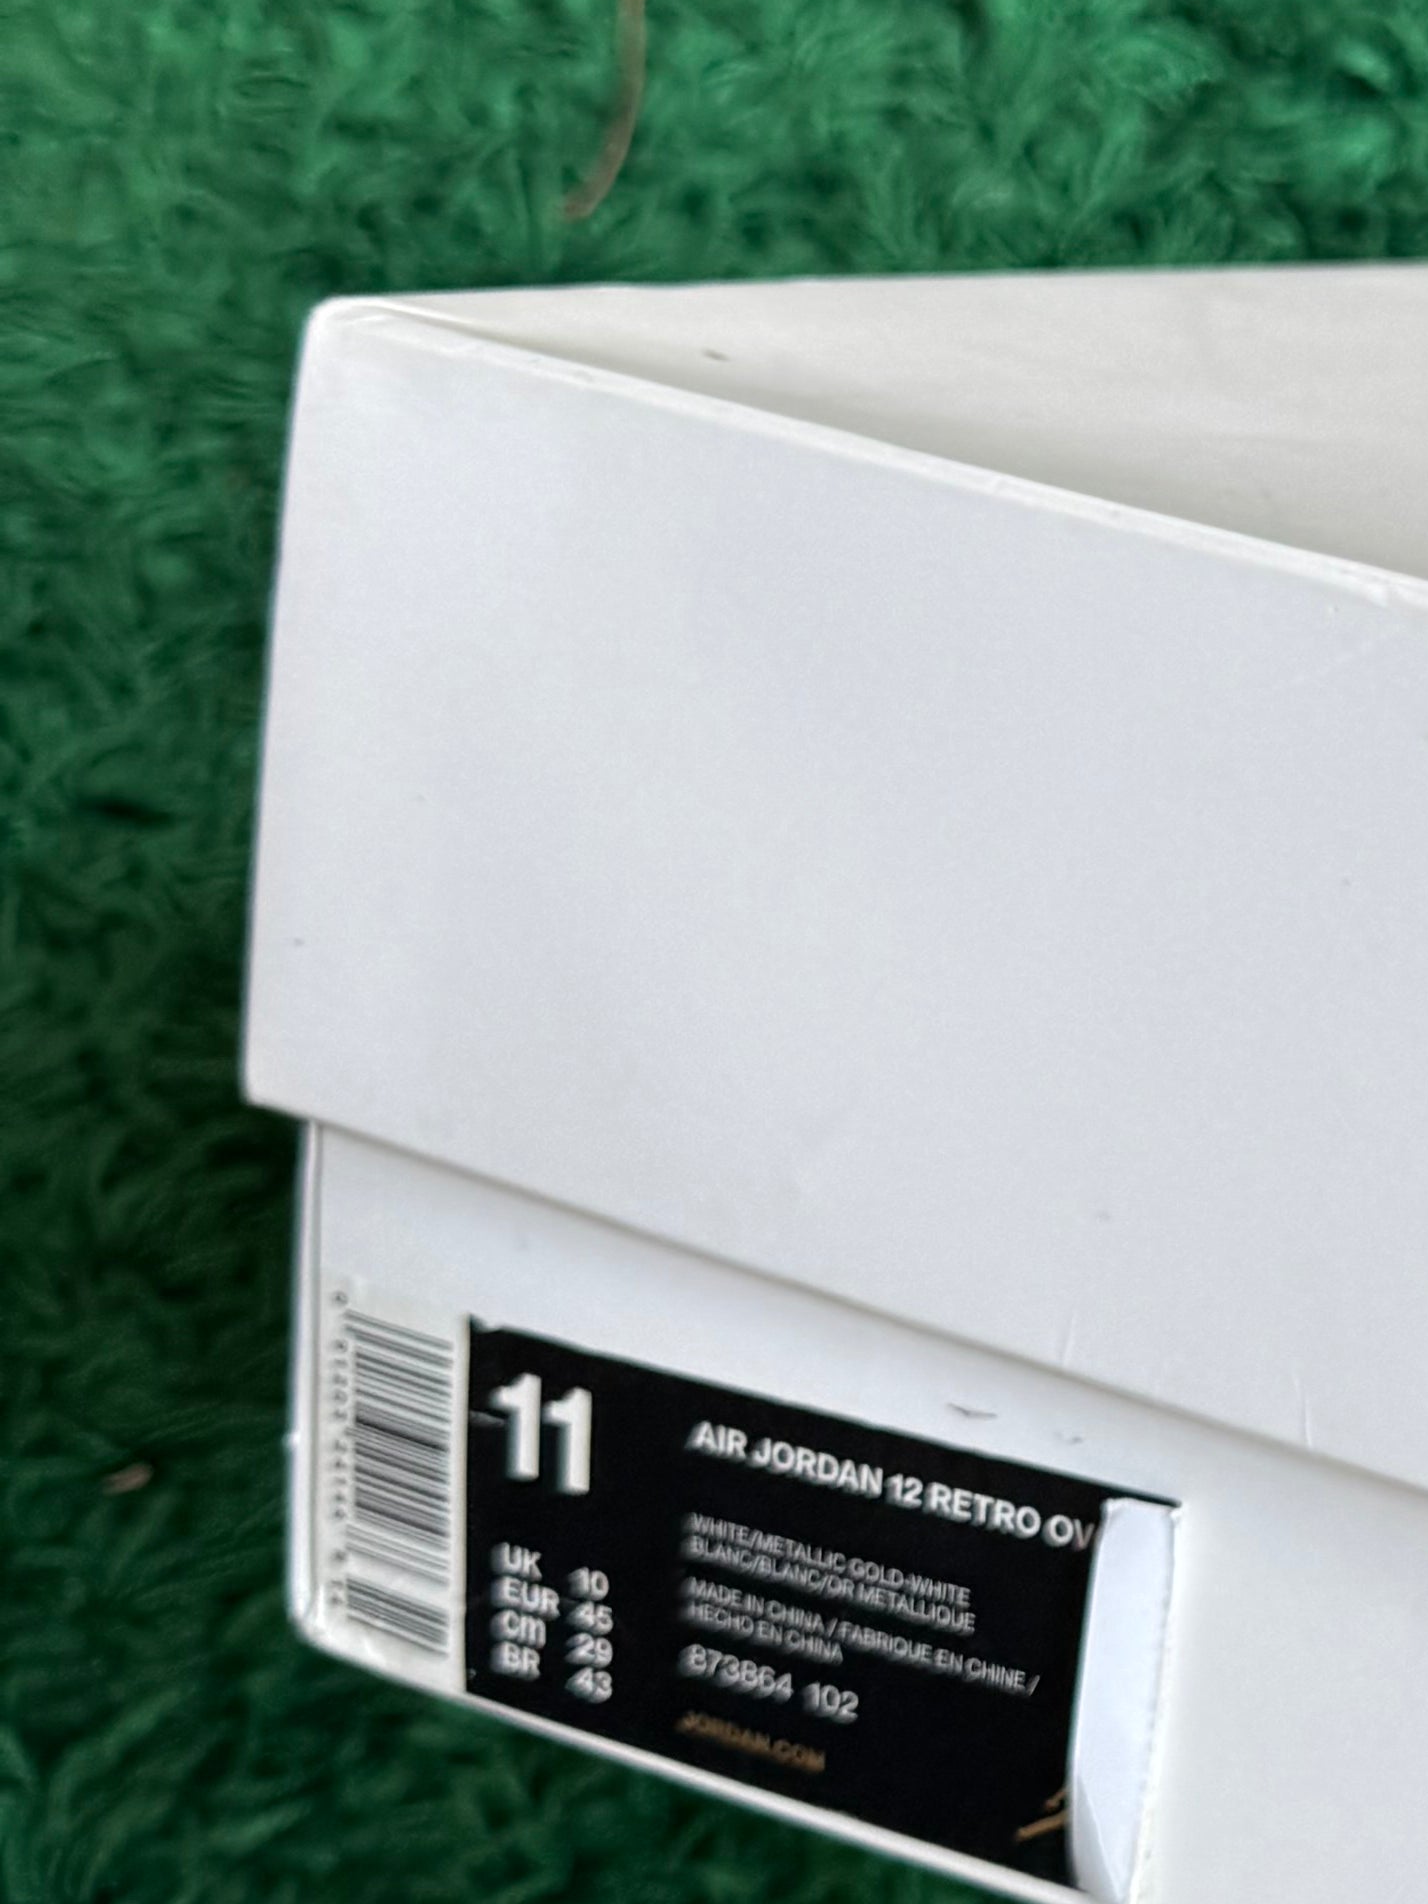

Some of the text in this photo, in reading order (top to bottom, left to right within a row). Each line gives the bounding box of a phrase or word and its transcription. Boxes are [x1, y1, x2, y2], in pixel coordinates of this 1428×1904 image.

[490, 1371, 592, 1495] 11
[687, 1420, 1100, 1550] AIR JORDAN 12 RETRO OV
[492, 1542, 610, 1601] UK 10
[492, 1576, 561, 1620] EUR
[682, 1535, 976, 1636] BLANC/BLANC/OR METALLIQUE
[684, 1512, 971, 1608] WHITE/METALLIC GOLD-WHITE
[491, 1641, 613, 1703] BR 43
[565, 1633, 613, 1668] 29
[682, 1576, 743, 1607] MADE
[744, 1594, 764, 1616] IN
[765, 1600, 824, 1635] CHINA
[837, 1621, 933, 1664] FABRIQUE
[933, 1648, 964, 1673] EN
[964, 1657, 1026, 1694] CHINE
[683, 1602, 844, 1665] HECHO EN CHINA
[678, 1644, 859, 1724] 873864 102
